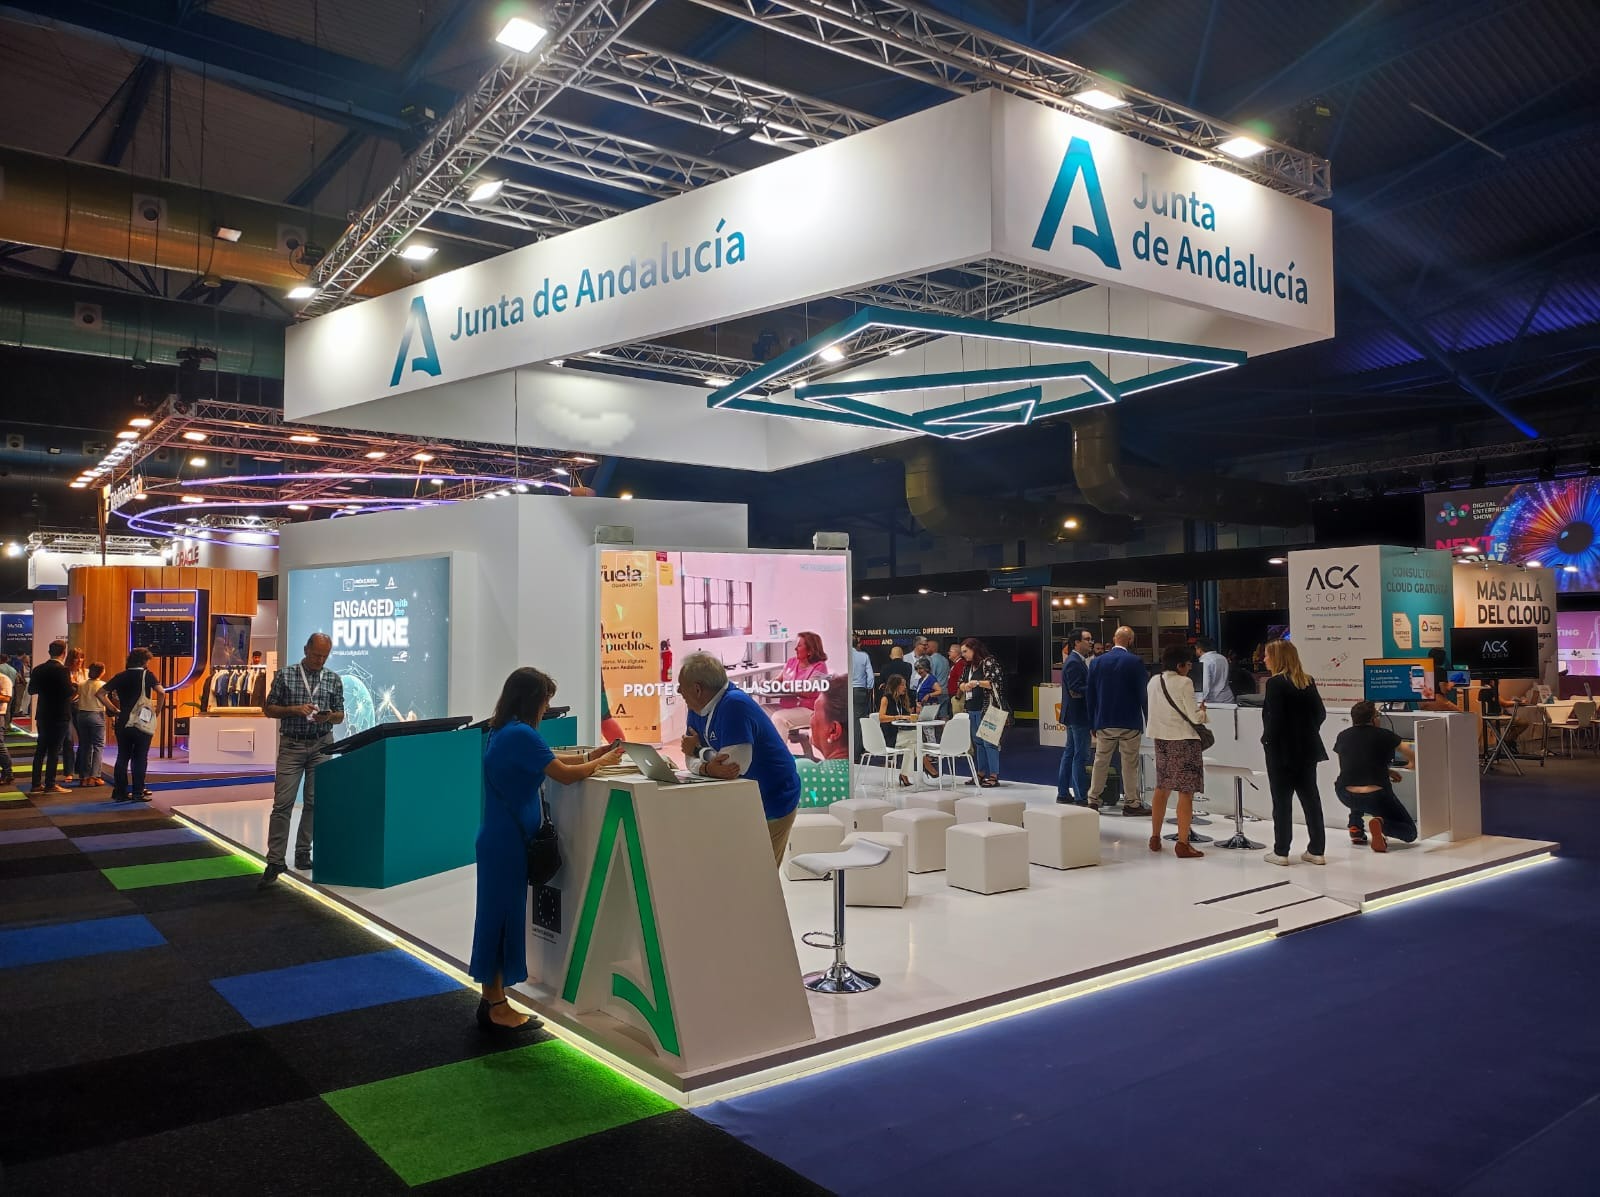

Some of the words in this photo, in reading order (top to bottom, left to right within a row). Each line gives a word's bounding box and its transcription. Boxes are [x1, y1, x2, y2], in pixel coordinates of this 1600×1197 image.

[1133, 172, 1216, 232] Junta
[1132, 222, 1169, 266] de
[1176, 236, 1308, 305] Andalucía
[449, 294, 524, 341] Junta
[533, 278, 568, 318] de
[575, 218, 746, 308] Andalucía
[1472, 506, 1510, 514] ENTERPRISE
[1494, 542, 1507, 553] IS
[601, 565, 642, 582] uela
[1305, 564, 1360, 590] ACK
[1392, 567, 1443, 579] CONSULTO
[1386, 582, 1413, 593] CLOUD
[1477, 576, 1506, 601] MÁS
[1510, 578, 1543, 602] ALLÁ
[1305, 592, 1361, 603] STORM
[333, 599, 394, 618] ENGAGED
[1478, 604, 1504, 625] DEL
[1507, 604, 1551, 625] CLOUD
[332, 617, 409, 648] FUTURE
[631, 630, 642, 639] to
[605, 640, 654, 654] pueblos.
[1482, 640, 1508, 652] ACK
[763, 679, 830, 693] SOCIEDAD
